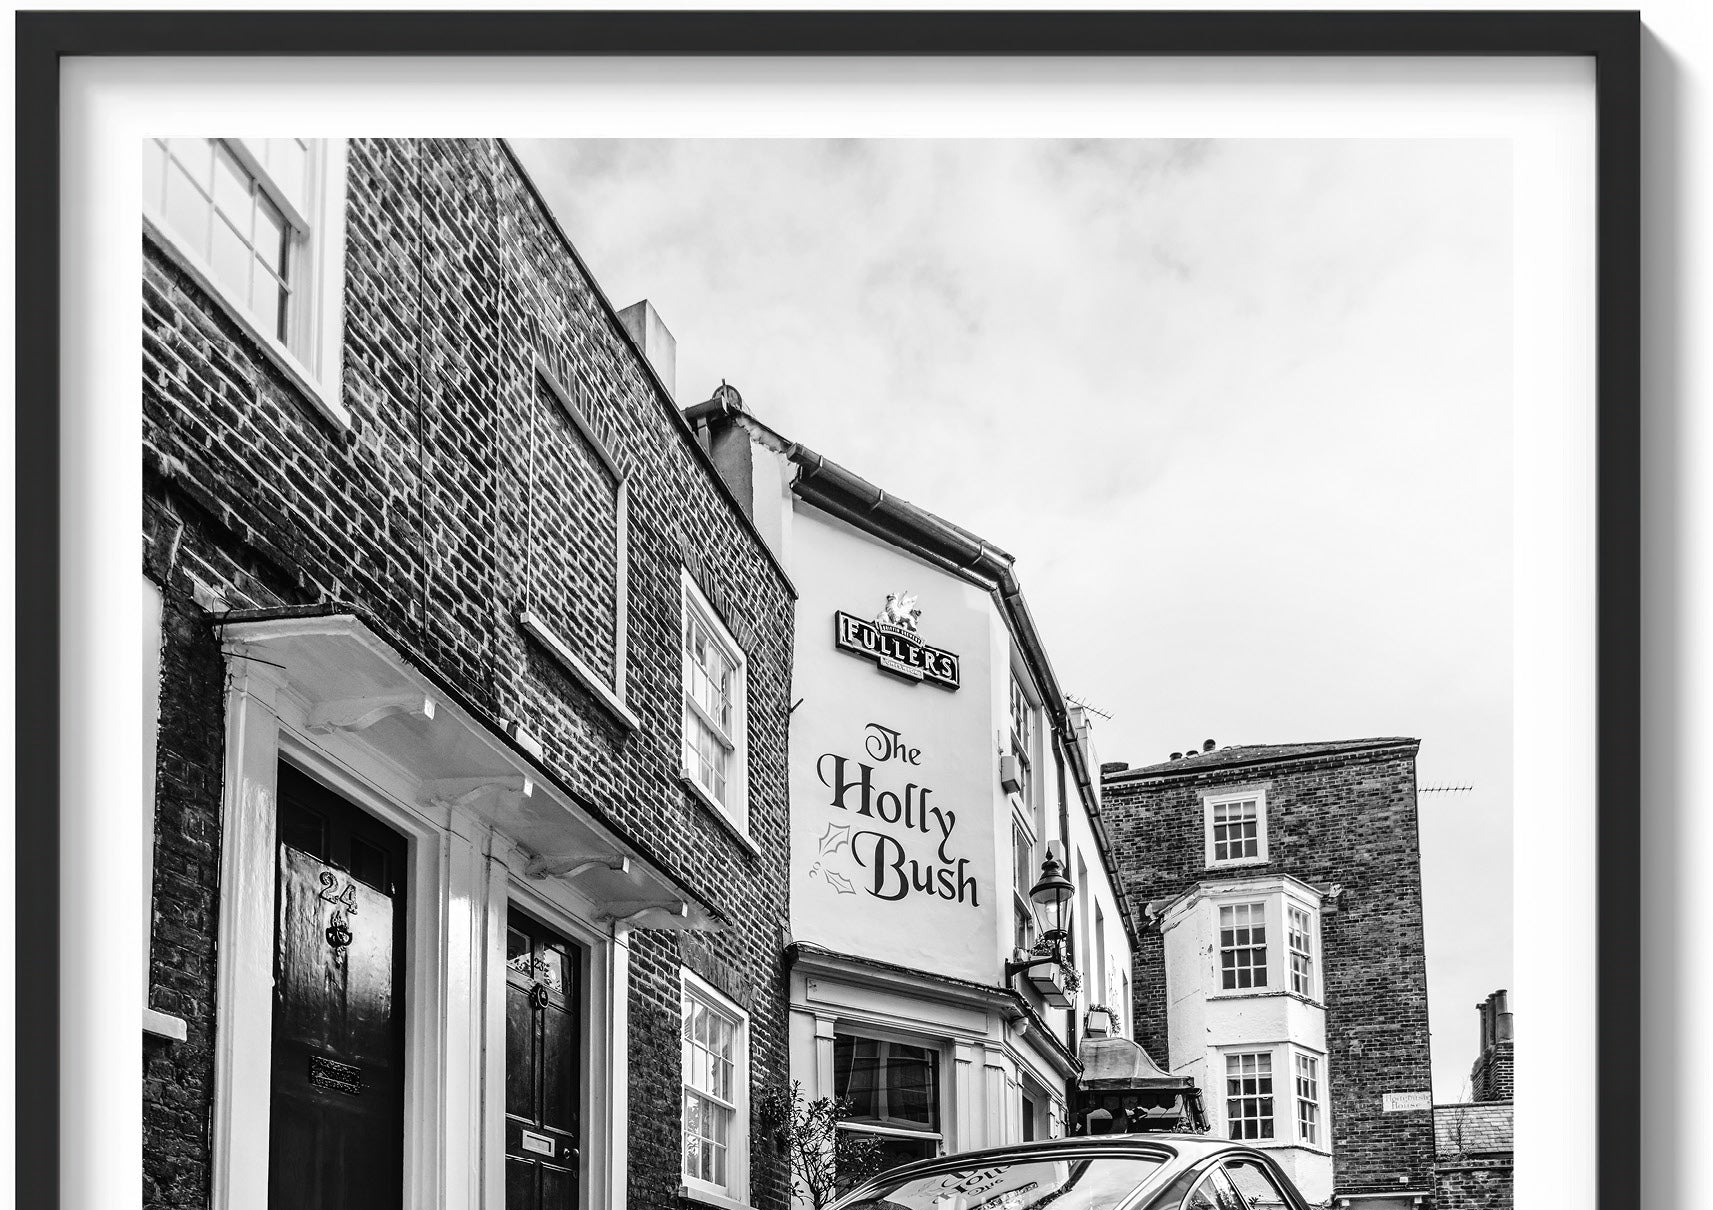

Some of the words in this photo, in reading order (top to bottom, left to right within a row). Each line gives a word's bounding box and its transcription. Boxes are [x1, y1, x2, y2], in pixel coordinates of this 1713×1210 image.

[864, 722, 922, 766] The
[816, 753, 957, 863] Holly
[319, 871, 358, 915] 24
[851, 830, 980, 907] Bush
